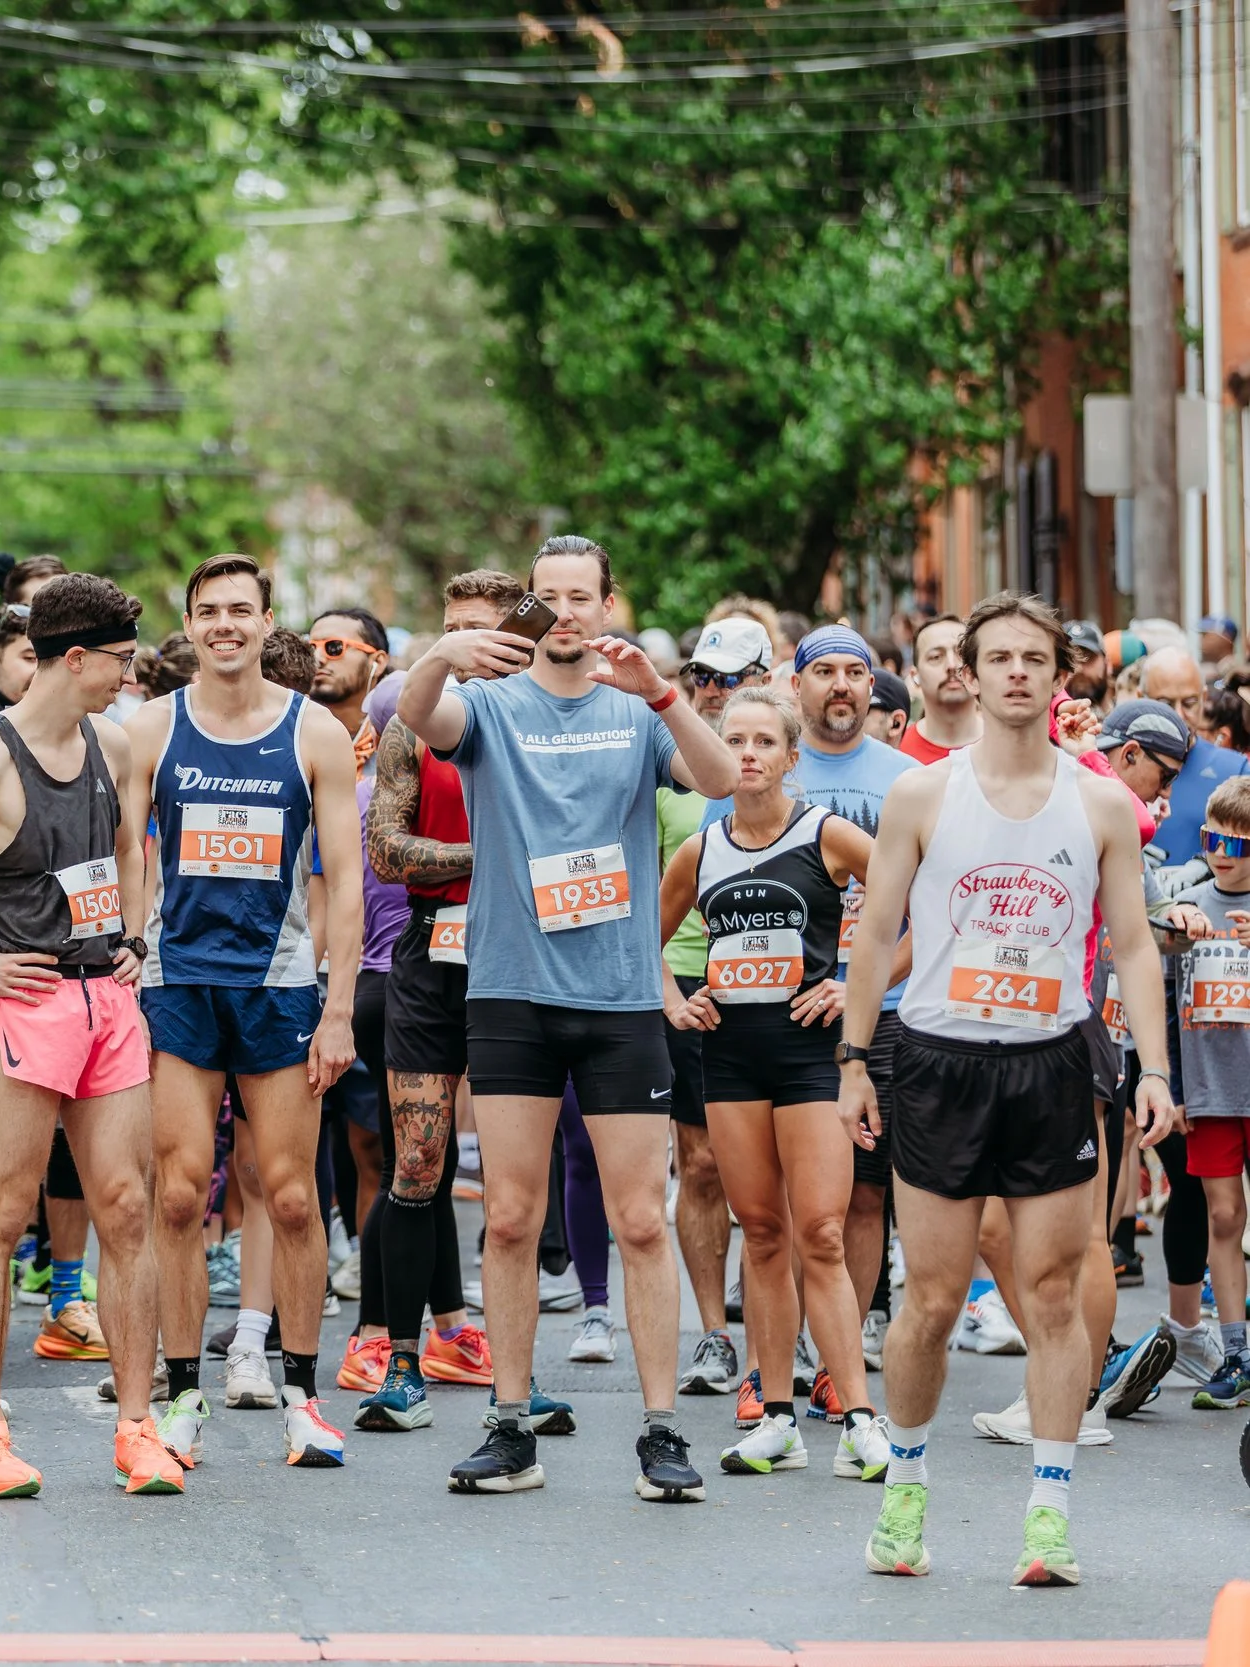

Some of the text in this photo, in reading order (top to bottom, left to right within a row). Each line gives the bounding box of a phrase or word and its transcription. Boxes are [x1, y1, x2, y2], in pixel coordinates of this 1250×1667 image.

[525, 734, 549, 745] ALL
[551, 727, 636, 745] GENERATIONS
[197, 834, 264, 861] 1501
[550, 877, 617, 911] 1935
[734, 889, 766, 900] RUN
[959, 868, 1067, 909] Strawberry
[76, 889, 120, 920] 1500
[989, 893, 1038, 917] Hill
[720, 910, 785, 932] Myers
[970, 919, 1050, 937] TRACK CLUB
[718, 961, 792, 986] 6027
[971, 974, 1038, 1007] 264
